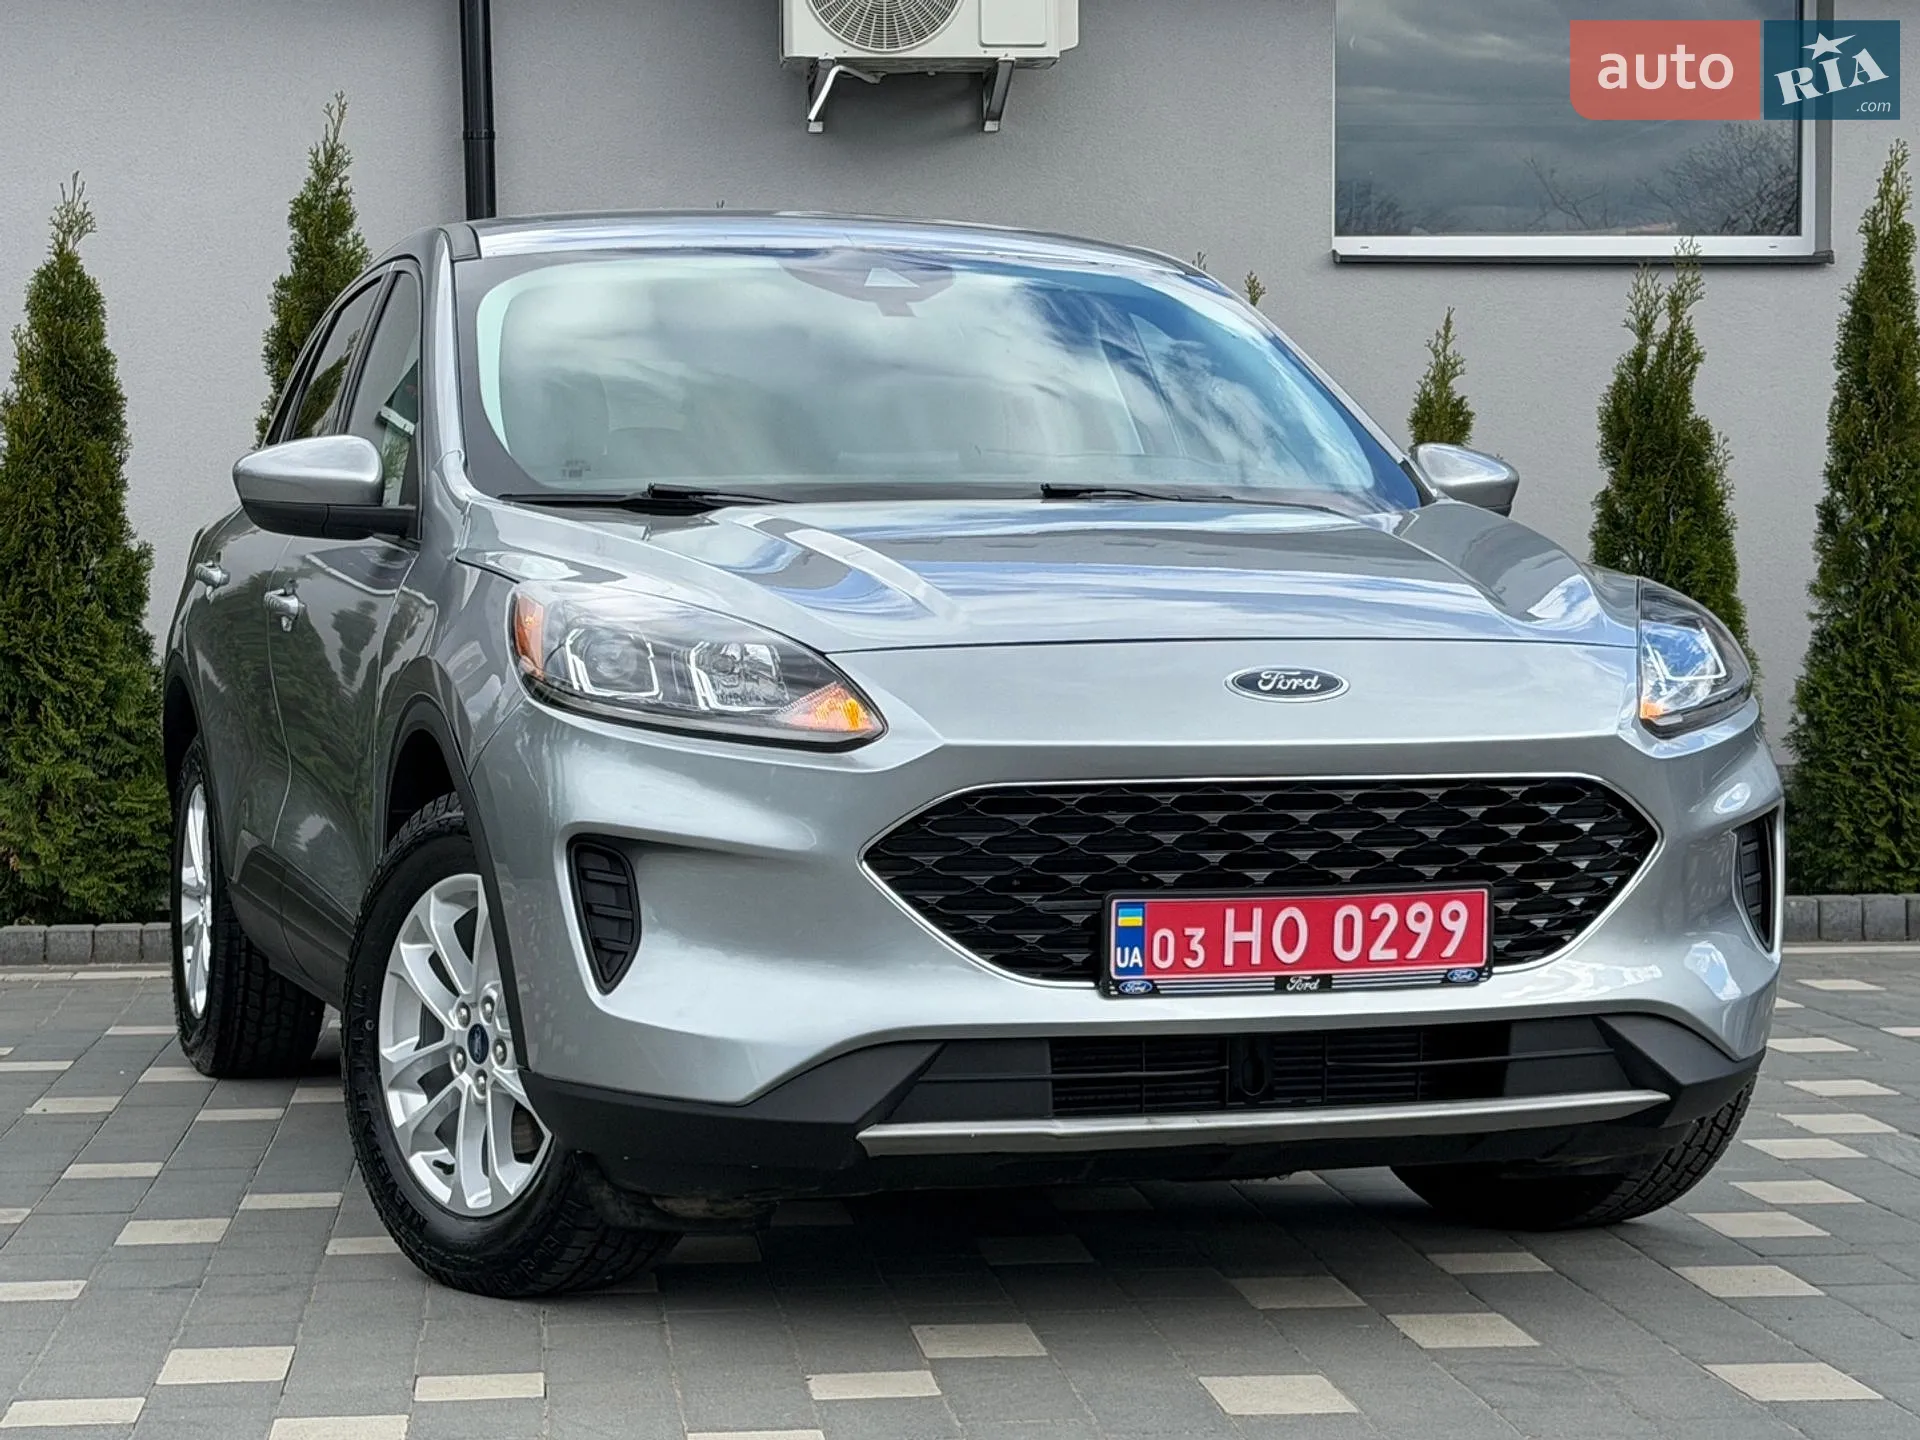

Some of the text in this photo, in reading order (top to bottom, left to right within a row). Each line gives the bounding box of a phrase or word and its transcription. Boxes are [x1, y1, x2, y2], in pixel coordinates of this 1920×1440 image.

[1257, 670, 1321, 691] Ford
[1152, 899, 1469, 969] 03 HO 0299
[1116, 946, 1143, 969] UA
[1286, 975, 1320, 991] Ford
